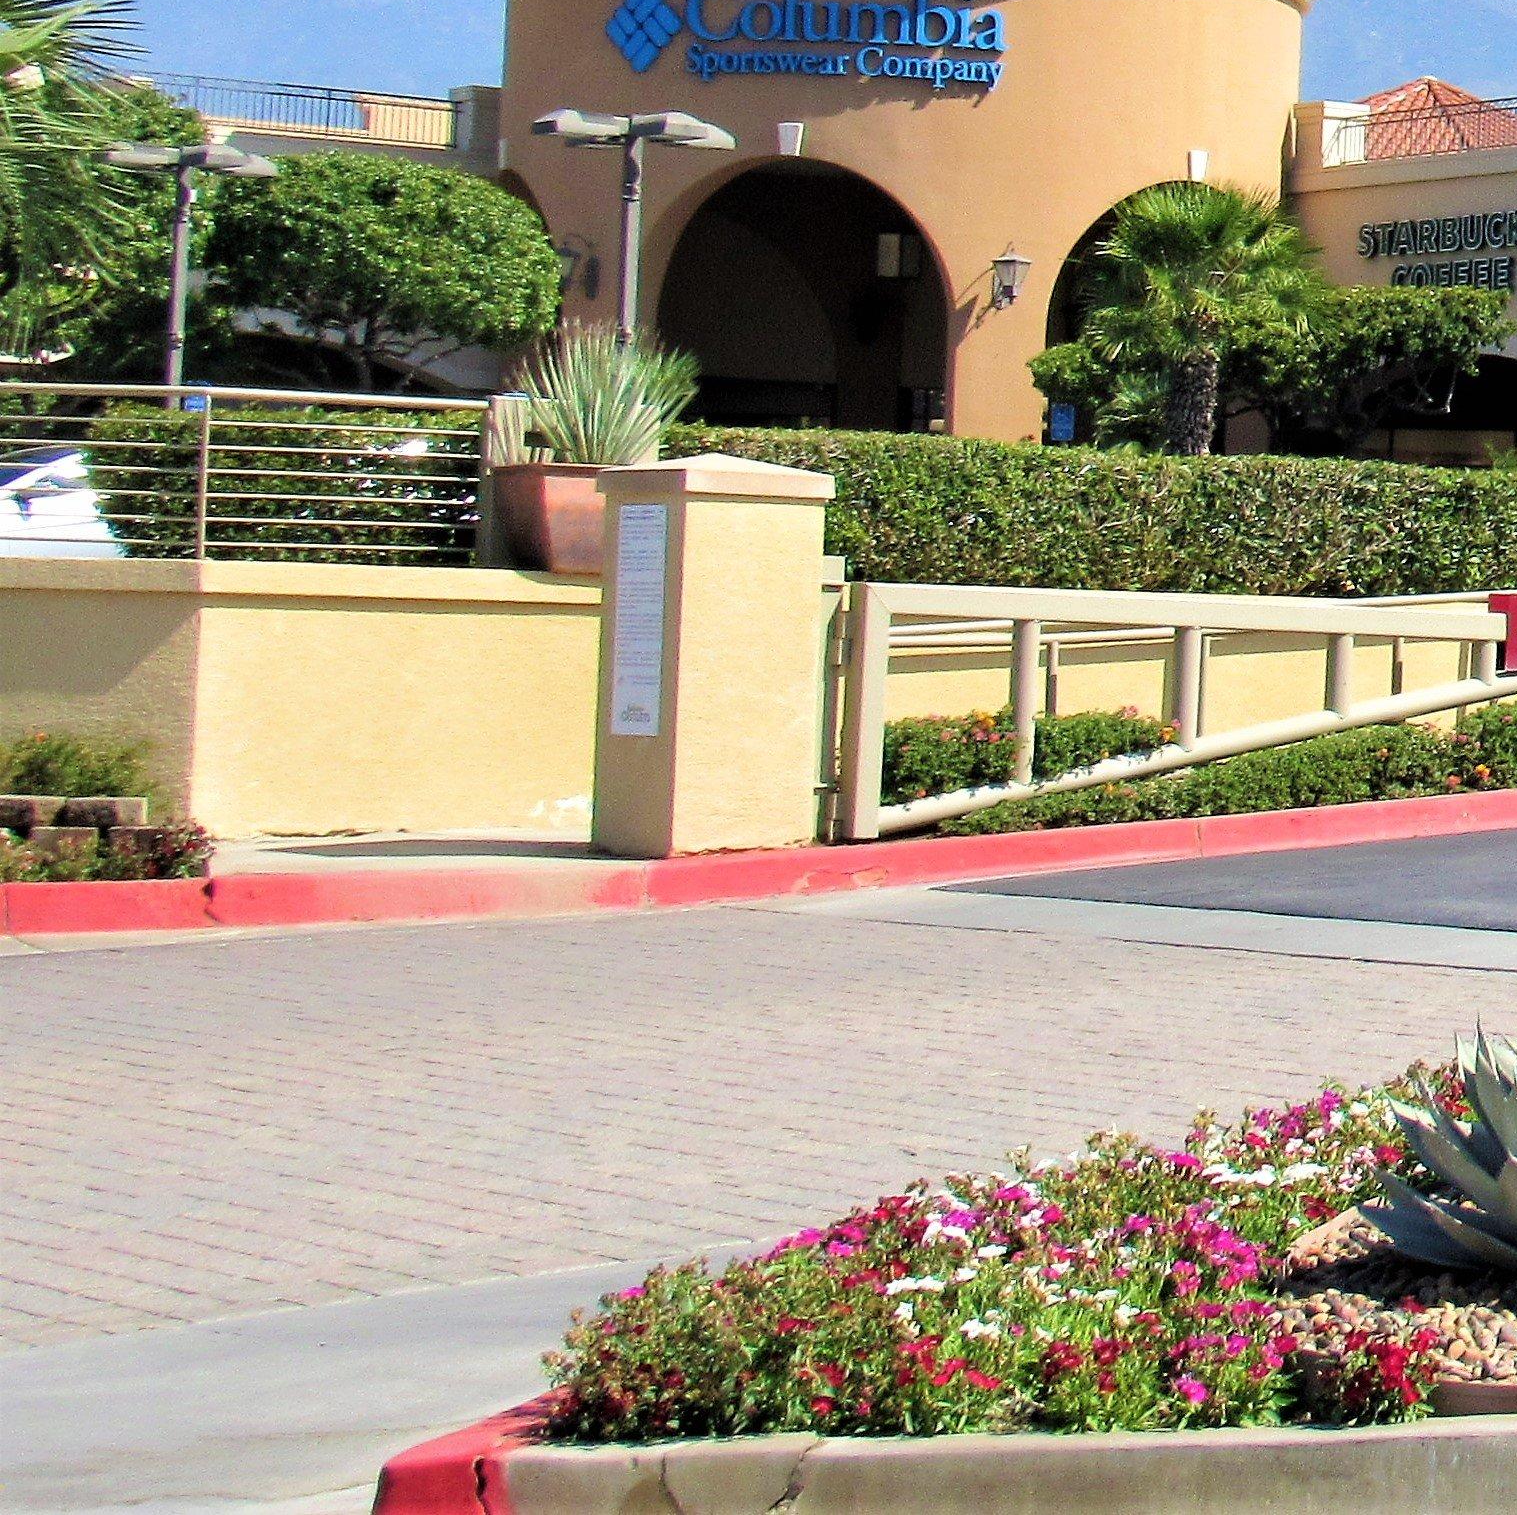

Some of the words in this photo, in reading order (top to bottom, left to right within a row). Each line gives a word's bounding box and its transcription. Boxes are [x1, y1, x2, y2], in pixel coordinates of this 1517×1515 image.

[686, 45, 848, 81] Sportswear
[855, 46, 1007, 91] Company
[1391, 255, 1516, 289] COFFEE
